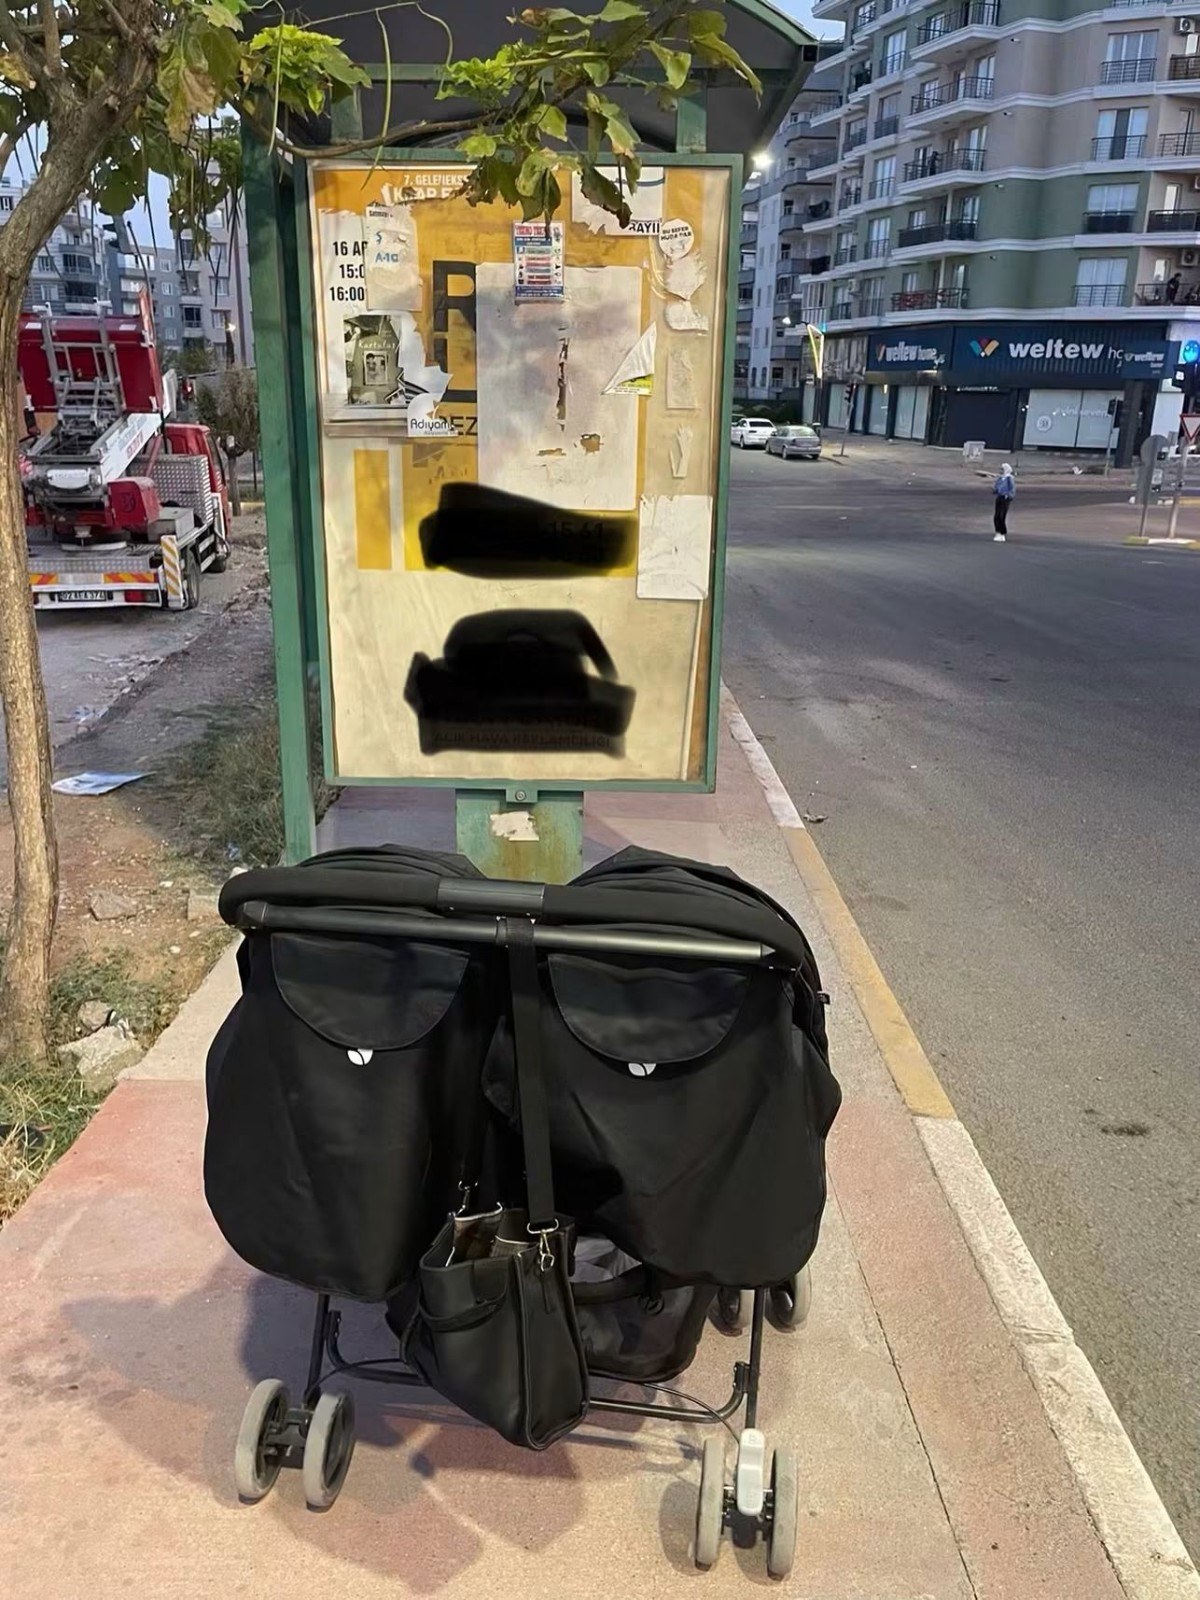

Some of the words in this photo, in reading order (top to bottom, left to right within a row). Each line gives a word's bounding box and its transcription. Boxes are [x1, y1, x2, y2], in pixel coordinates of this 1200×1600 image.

[332, 241, 348, 256] 16
[329, 286, 365, 301] 16:00
[1008, 338, 1104, 359] weltew
